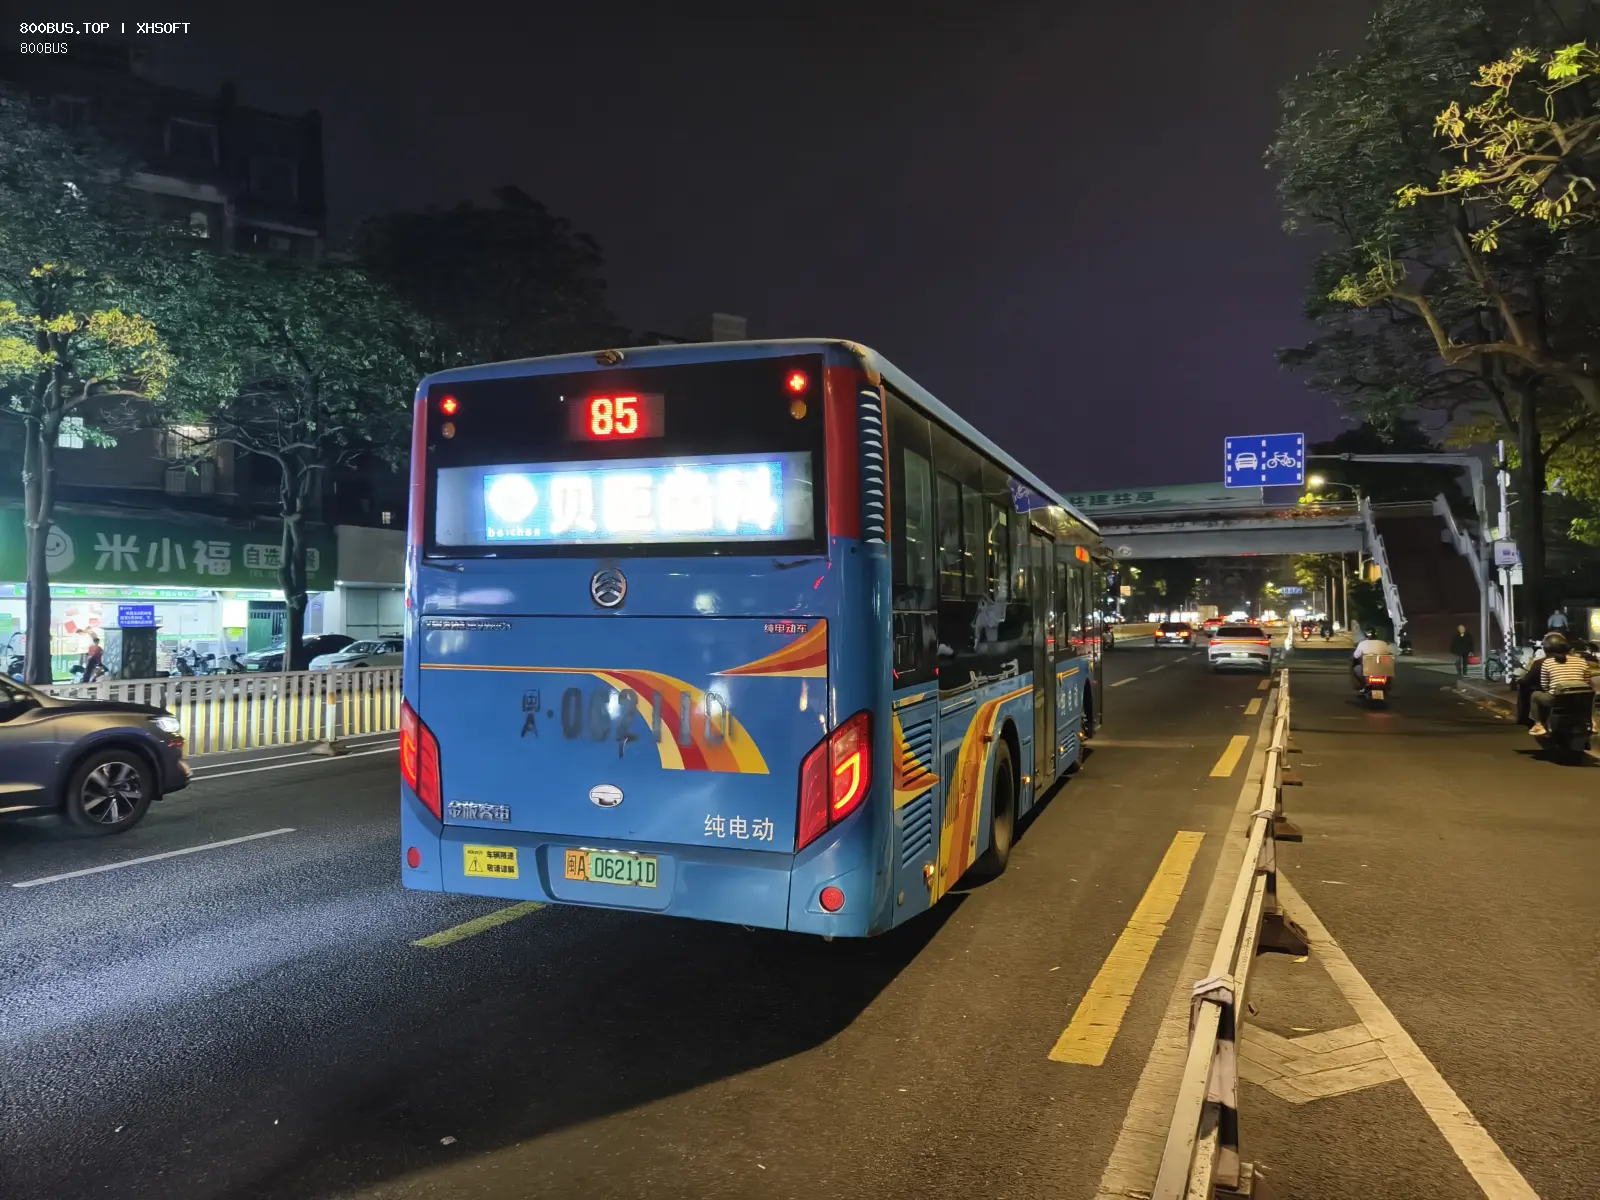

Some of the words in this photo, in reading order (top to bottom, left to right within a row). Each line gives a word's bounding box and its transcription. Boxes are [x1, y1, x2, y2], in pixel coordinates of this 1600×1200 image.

[591, 397, 638, 435] 85
[94, 532, 231, 576] 米小福
[763, 622, 808, 635] 纯电动车
[447, 799, 511, 824] 金旅客车
[704, 814, 774, 841] 纯电动
